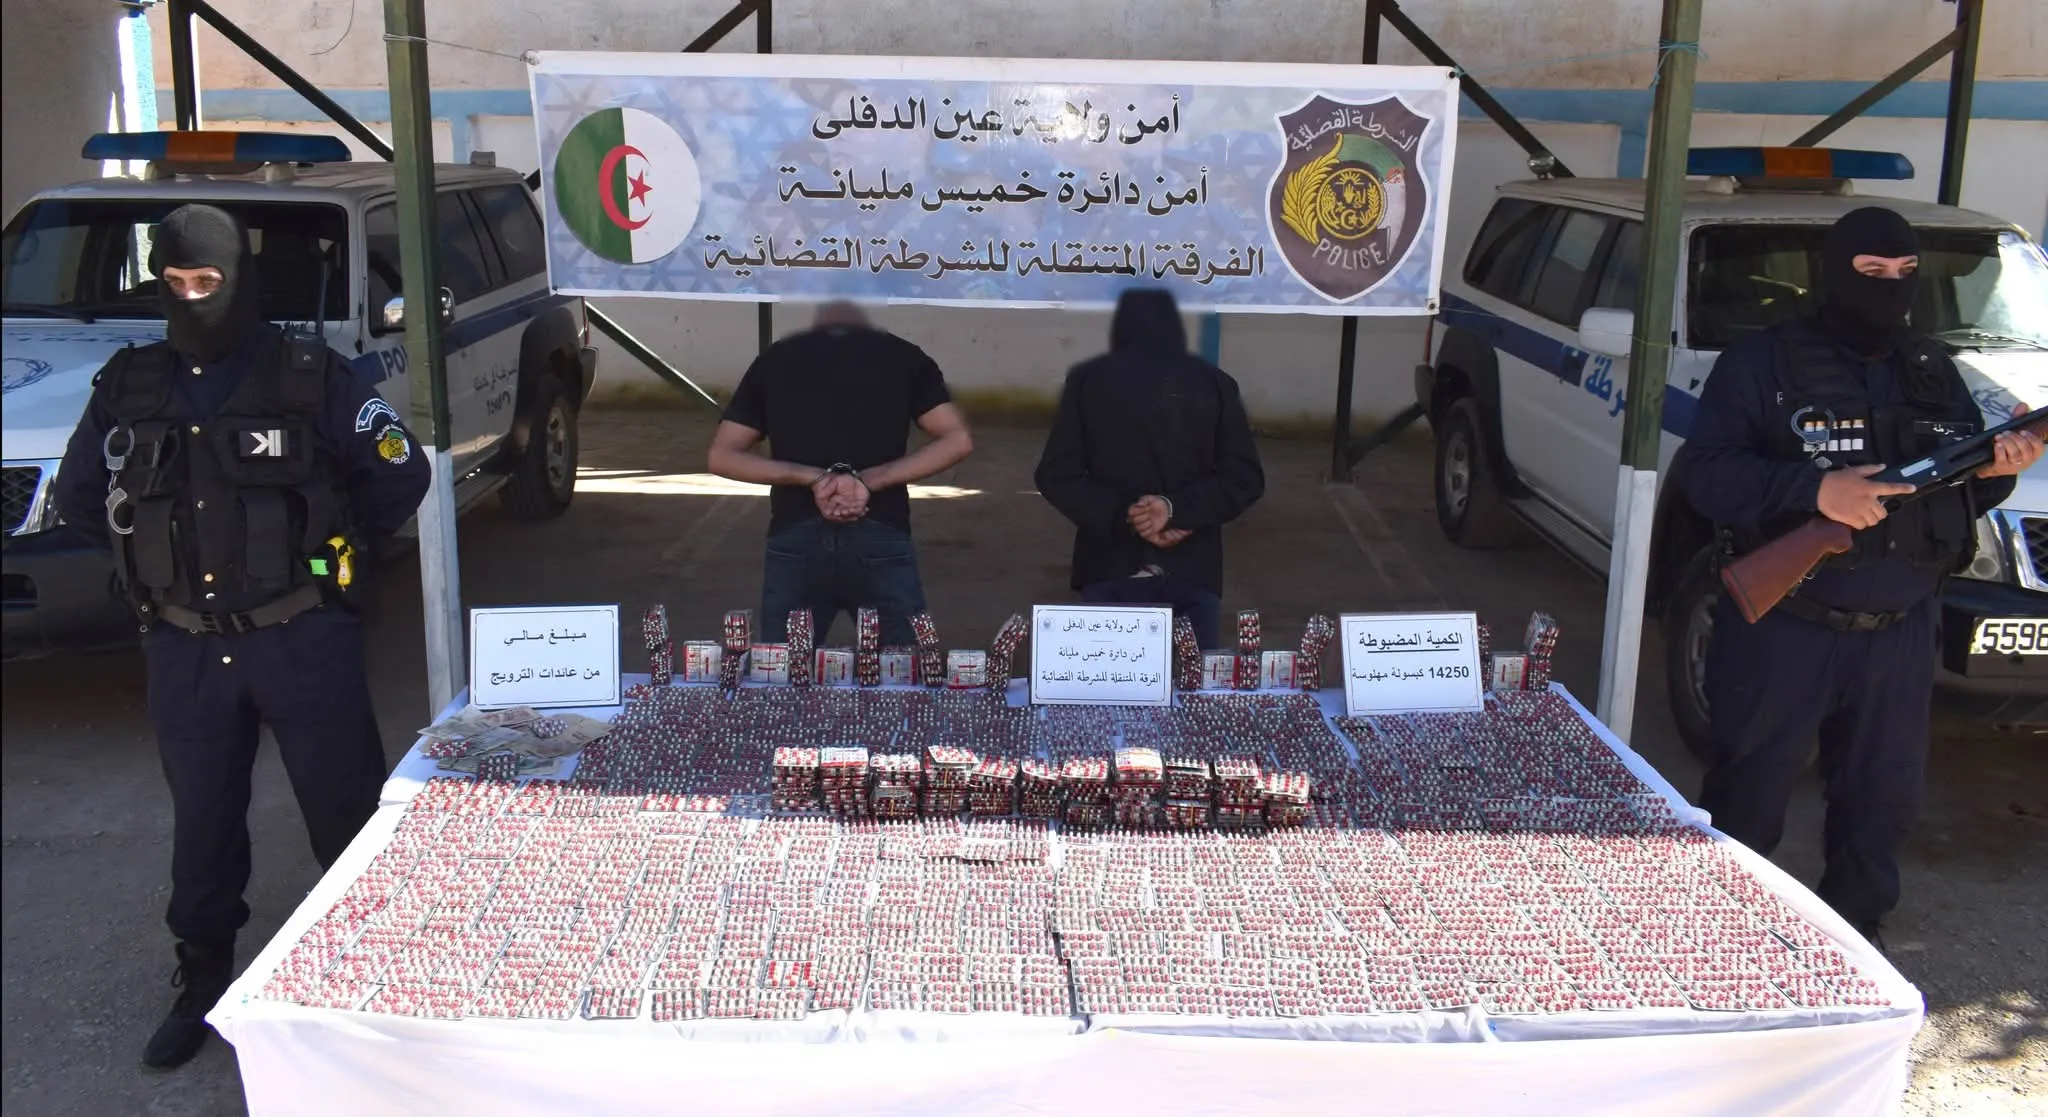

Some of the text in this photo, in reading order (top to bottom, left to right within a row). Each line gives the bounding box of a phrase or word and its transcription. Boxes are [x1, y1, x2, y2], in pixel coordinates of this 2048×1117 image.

[812, 93, 1179, 144] أمن ولاية عين الدفلى
[778, 165, 1207, 216] أمن دائرة خميس مليانة
[704, 234, 1264, 285] الفرقة المتنقلة للشرطة القضائية
[1312, 238, 1385, 271] POLICE
[1063, 617, 1140, 633] أمن ولاية عين الدفلى
[548, 628, 587, 645] مبلغ
[1359, 630, 1463, 650] الكمية المضبوطة
[1058, 647, 1145, 662] أمن دائرة خميس مليانة
[490, 666, 600, 685] من عائدات الترويج
[1041, 670, 1161, 687] الفرقة المتنقلة للشرطة القضائية
[1352, 666, 1470, 682] 14250 كبسولة مهلوسة
